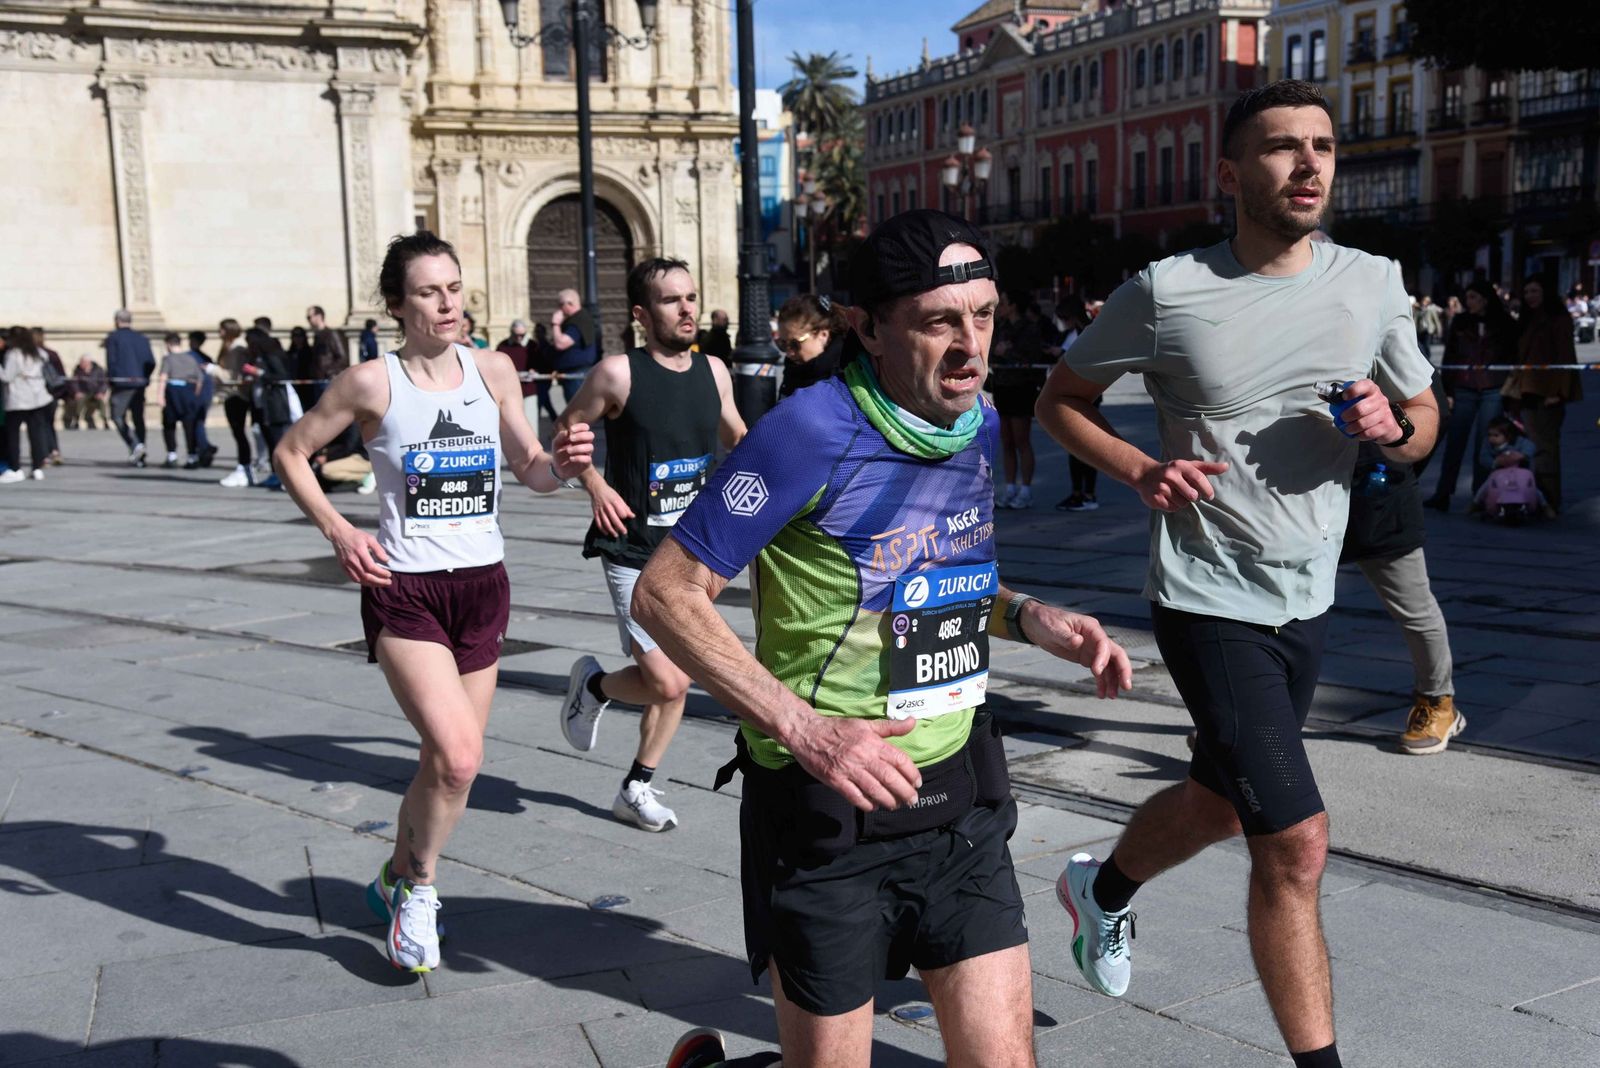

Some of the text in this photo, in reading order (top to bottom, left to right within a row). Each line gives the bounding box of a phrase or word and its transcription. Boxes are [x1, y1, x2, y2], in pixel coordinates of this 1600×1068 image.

[404, 435, 494, 452] PITTSBURGH
[440, 454, 488, 468] ZURICH
[441, 480, 468, 494] 4848
[416, 495, 488, 516] GREDDIE
[946, 506, 980, 535] AGEN
[870, 523, 940, 573] ASPTT
[938, 572, 992, 598] ZURICH
[938, 616, 962, 641] 4862
[916, 641, 980, 684] BRUNO
[906, 698, 925, 709] asics
